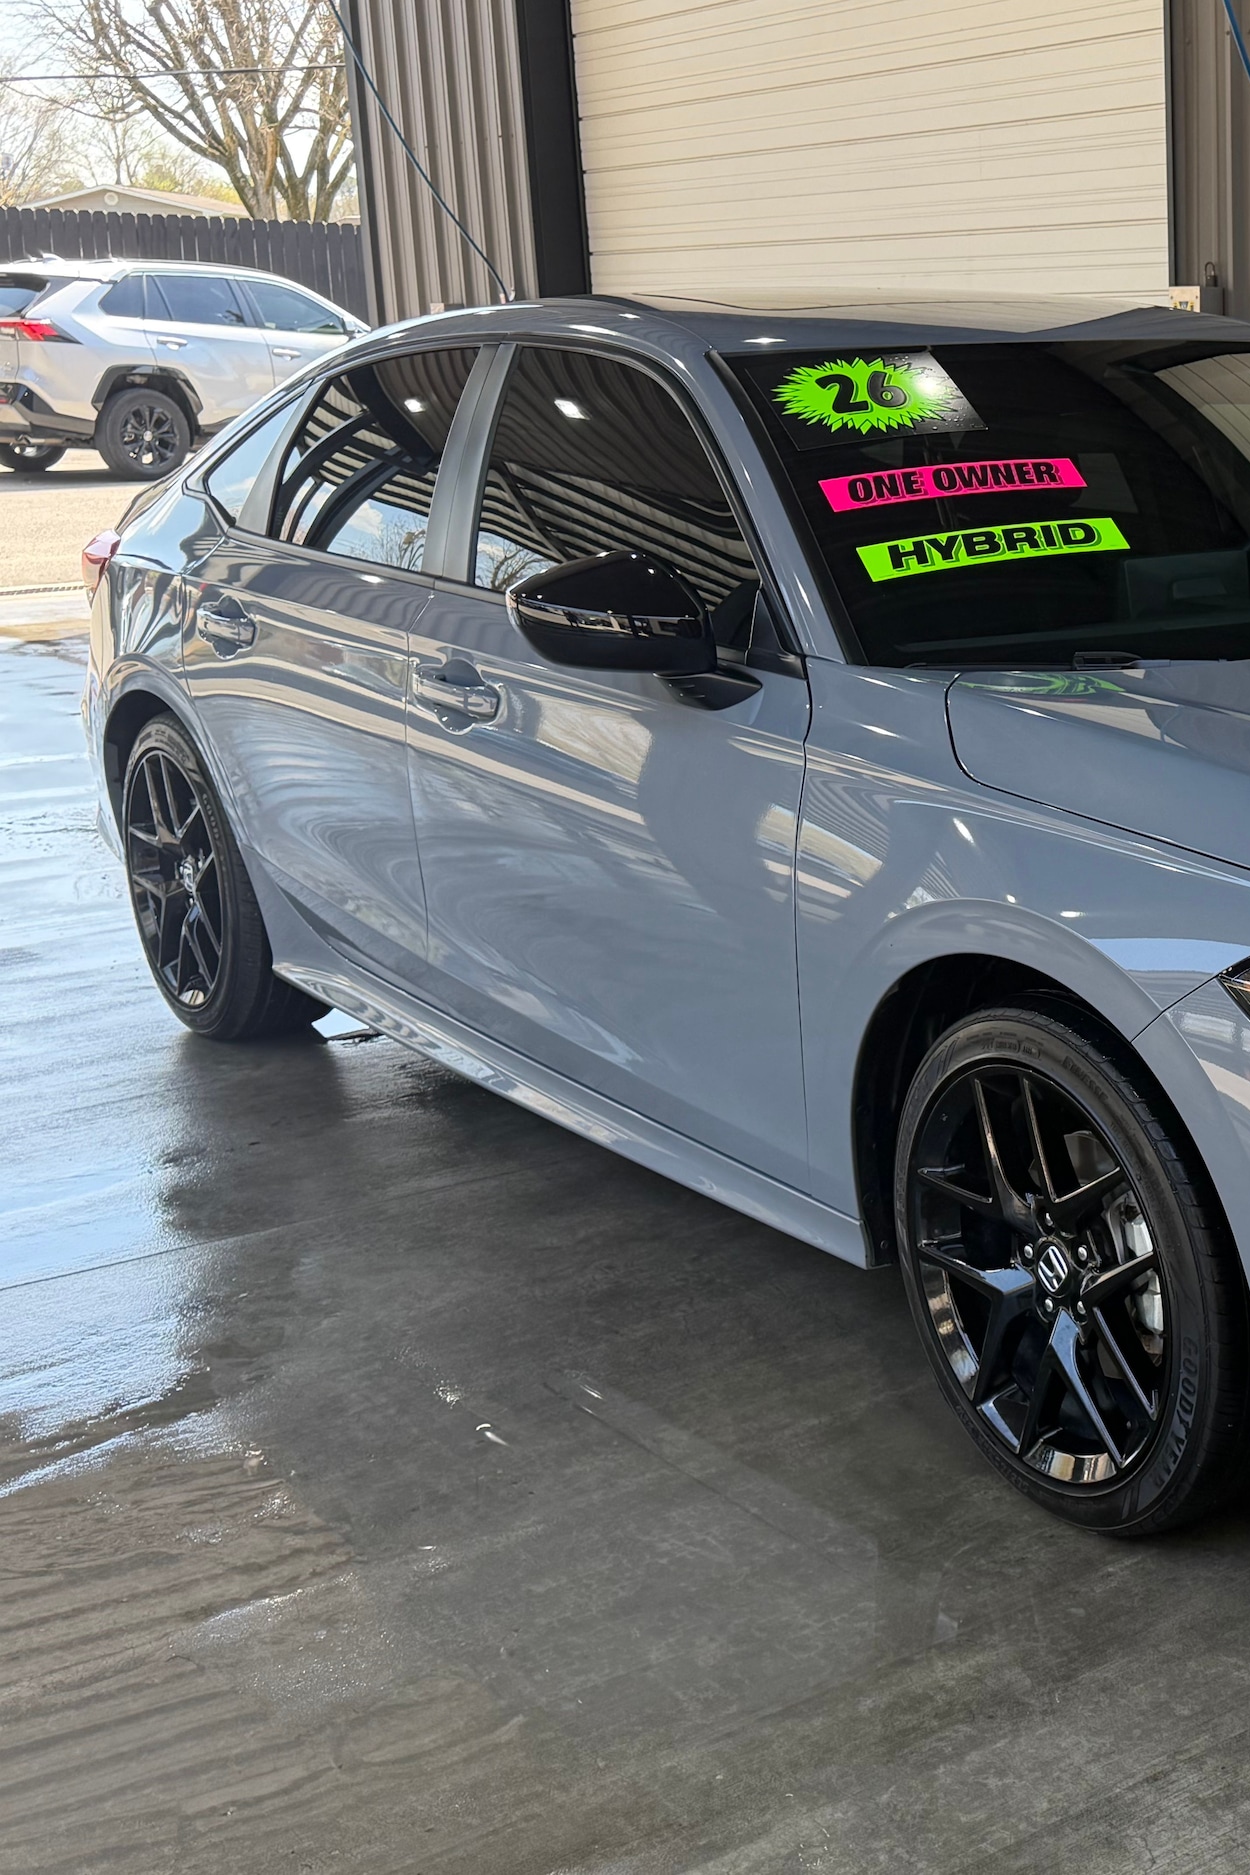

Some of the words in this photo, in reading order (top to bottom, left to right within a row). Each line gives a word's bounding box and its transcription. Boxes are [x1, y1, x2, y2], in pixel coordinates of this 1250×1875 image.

[814, 370, 908, 415] 26
[847, 471, 928, 504] ONE
[932, 461, 1065, 494] OWNER
[886, 521, 1103, 573] HYBRID
[1152, 1336, 1199, 1489] GOODYEAR
